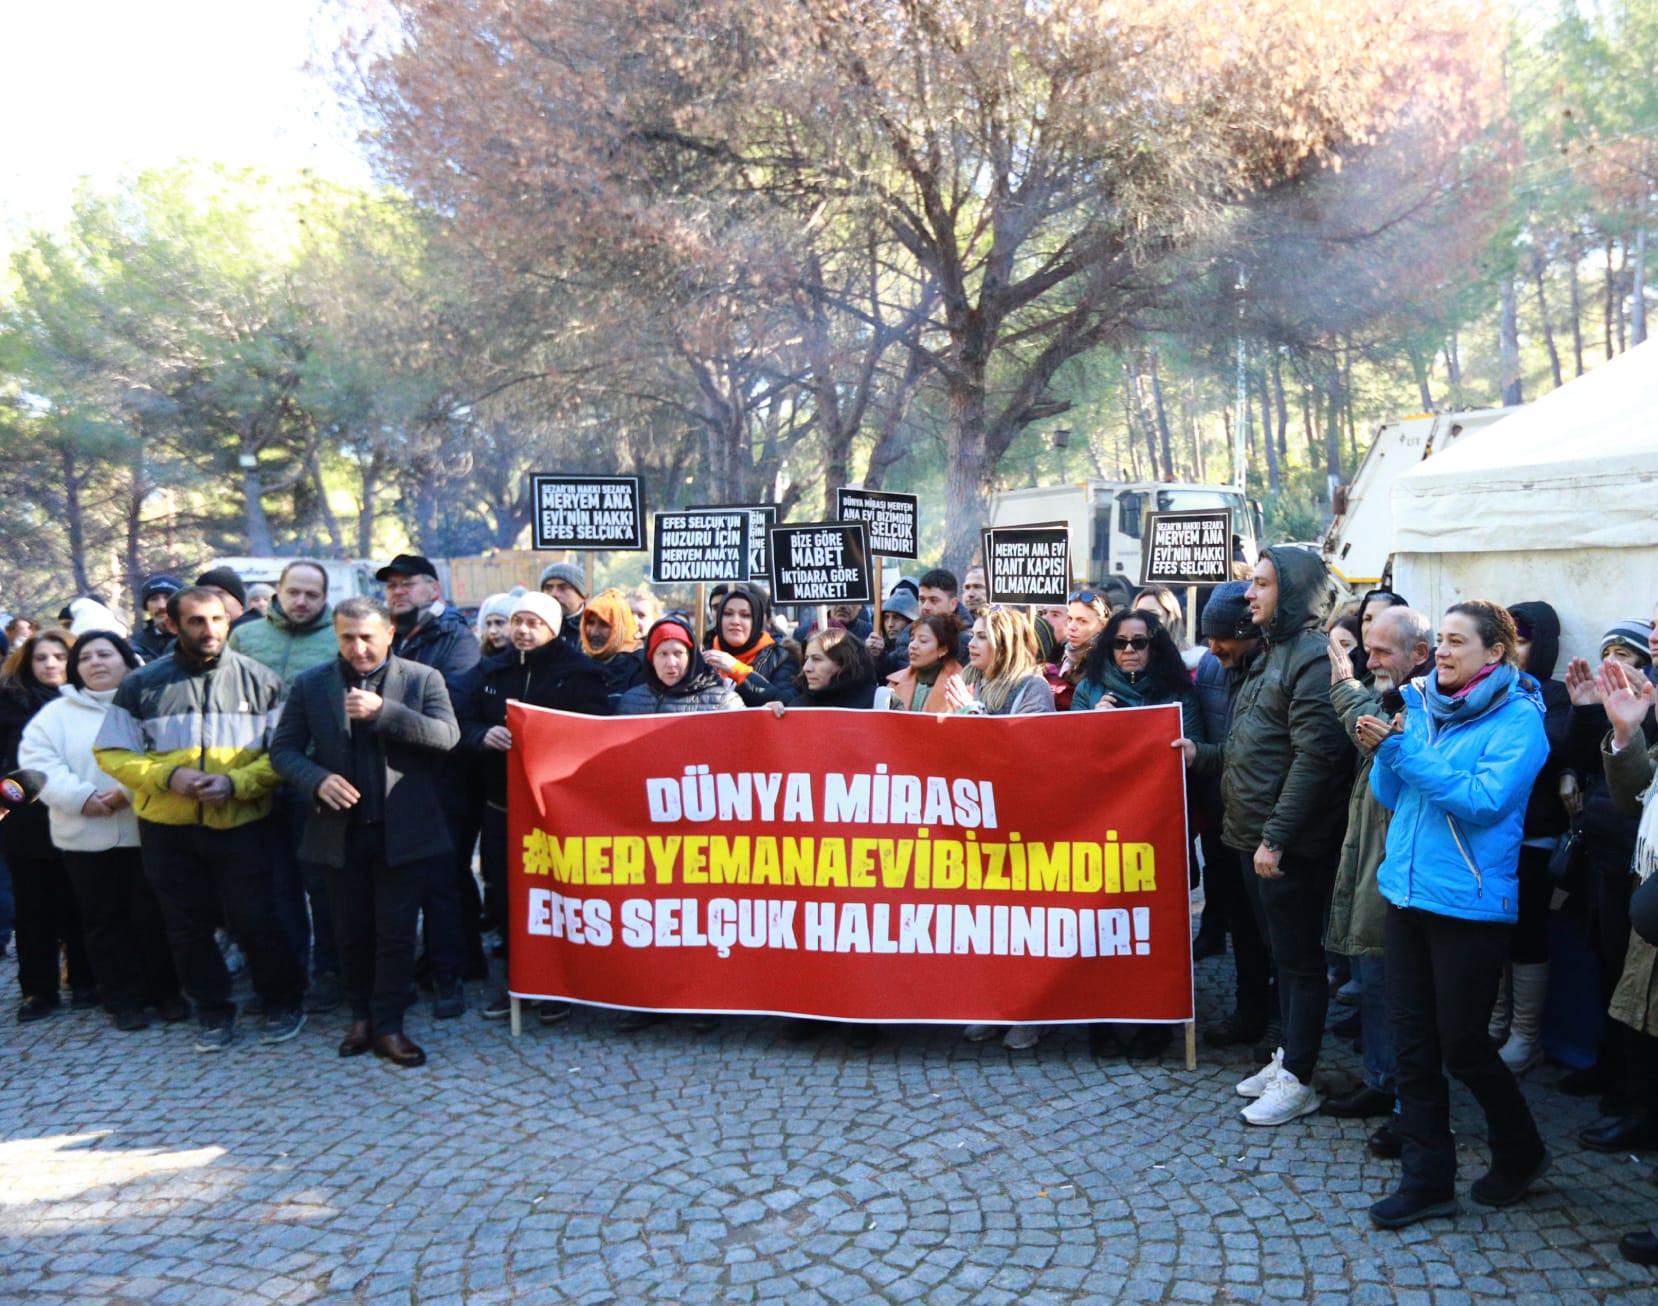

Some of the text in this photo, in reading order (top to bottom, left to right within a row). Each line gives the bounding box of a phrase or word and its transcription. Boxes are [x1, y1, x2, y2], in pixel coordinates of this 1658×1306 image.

[577, 484, 601, 494] HAKKI
[542, 494, 633, 509] MERYEM ANA
[843, 495, 864, 508] DÜNYA
[887, 501, 914, 512] MERYEM
[543, 507, 634, 525] EVİ'NİN HAKKI
[662, 515, 742, 530] EFES SELÇUK'UN
[843, 507, 913, 525] ANA EVİ BİZİMDİR
[543, 525, 634, 540] EFES SELÇUK'A
[871, 521, 913, 539] SELÇUK
[1182, 521, 1201, 530] HAKKI
[662, 528, 740, 548] HUZURU İÇİN
[791, 530, 843, 548] BİZE GÖRE
[870, 536, 914, 553] ININDIR!
[1156, 529, 1224, 545] MERYEM ANA
[661, 548, 740, 562] MERYEM ANA'YA
[791, 546, 844, 567] MABET
[995, 539, 1066, 557] MERYEM ANA EVİ
[1154, 546, 1224, 561] EVİ'NİN HAKKI
[661, 561, 739, 579] DOKUNMA!
[781, 566, 859, 584] İKTİDARA GÖRE
[995, 558, 1065, 575] RANT KAPISI
[1152, 561, 1225, 575] EFES SELÇUK'A
[794, 582, 847, 599] MARKET!
[995, 576, 1065, 594] OLMAYACAK!
[646, 763, 998, 829] DÜNYA MİRASI
[522, 828, 1156, 893] #MERYEMANAEVİBİZİMDİR
[528, 888, 1151, 958] EFES SELÇUK HALKININDIR!
